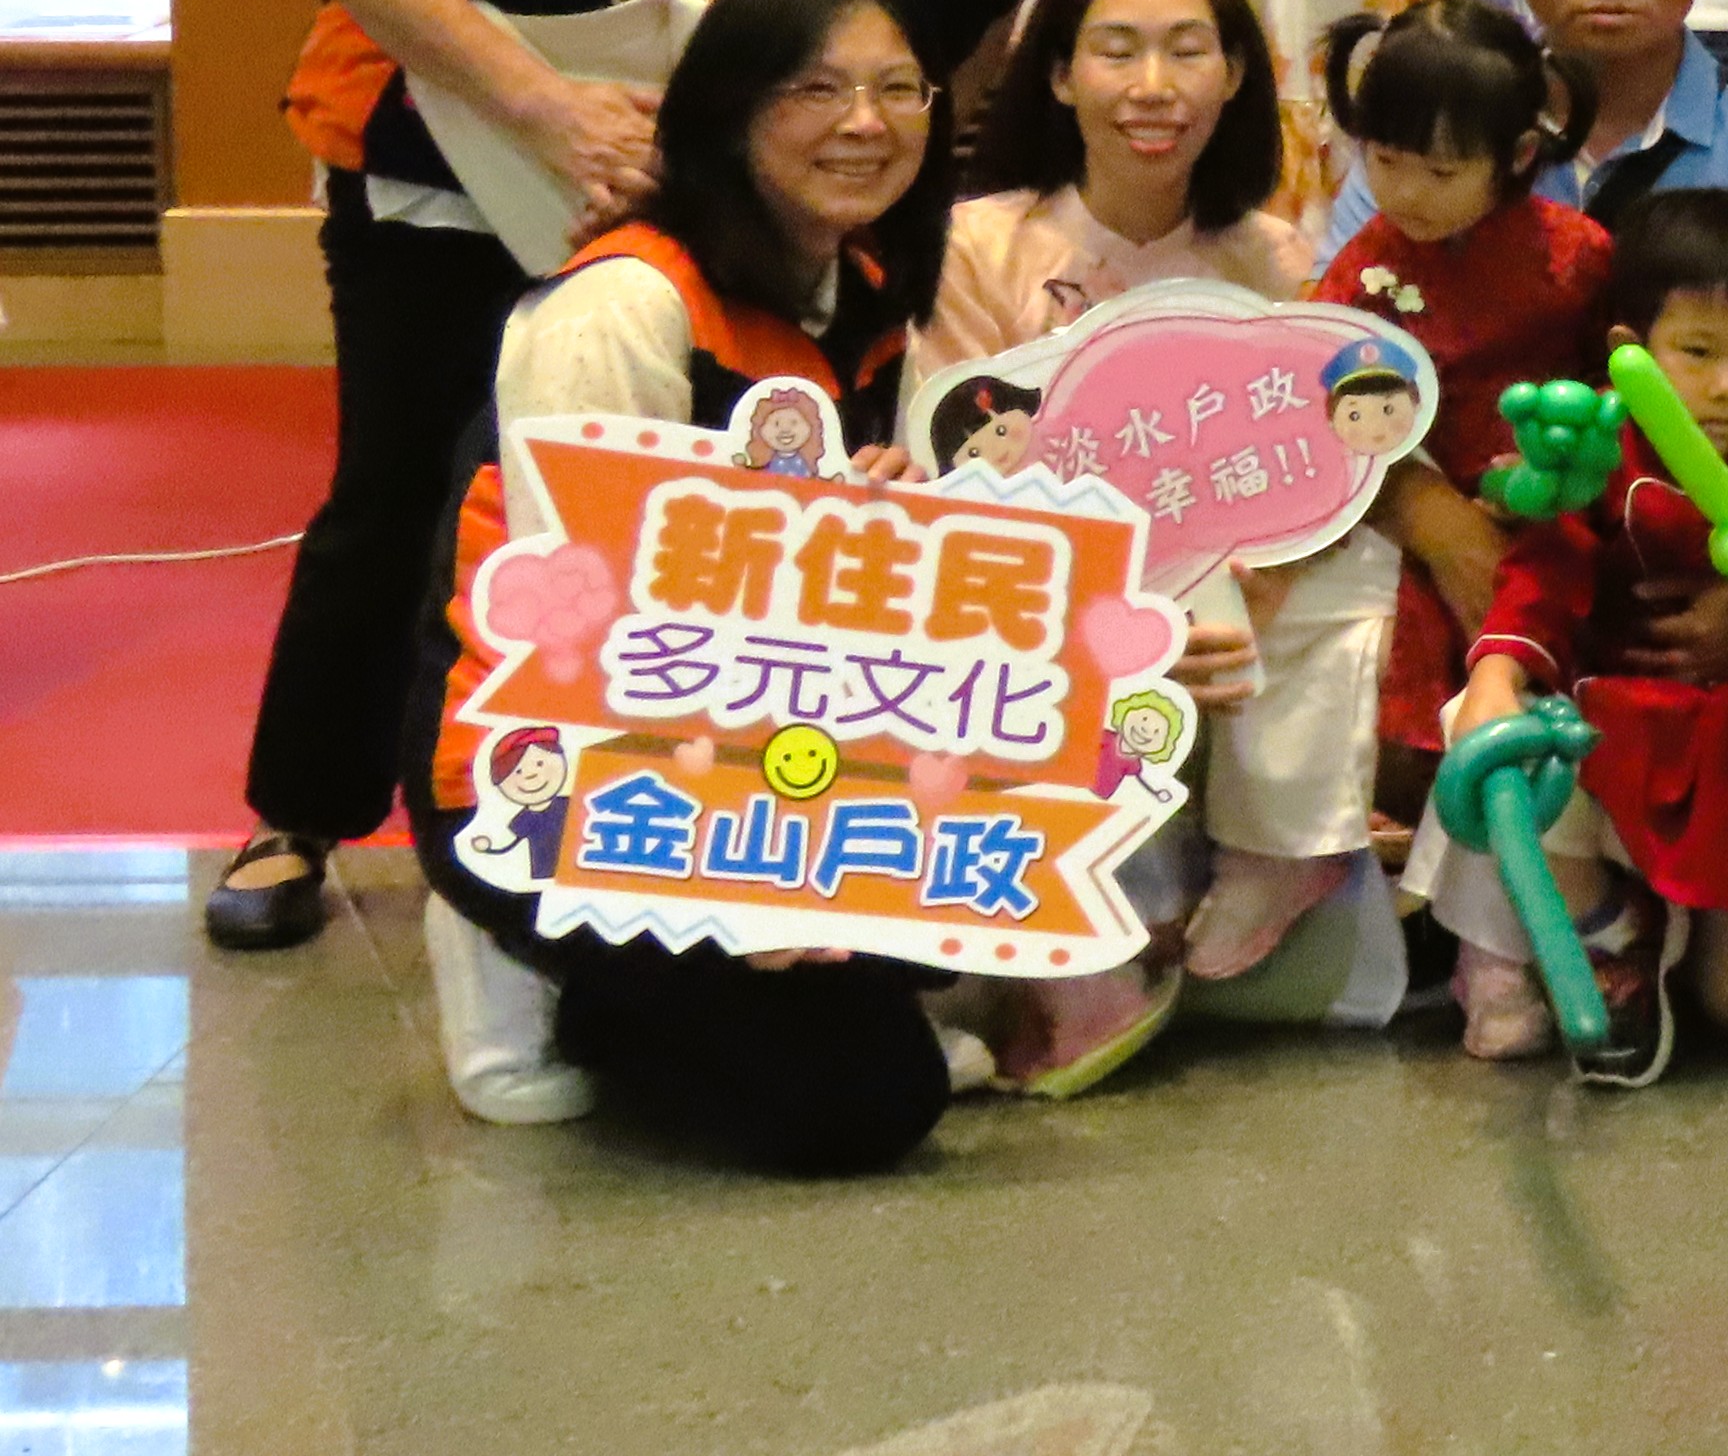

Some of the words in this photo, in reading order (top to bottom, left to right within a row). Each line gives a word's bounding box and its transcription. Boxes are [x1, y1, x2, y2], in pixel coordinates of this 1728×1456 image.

[654, 494, 1058, 649] 新住民
[617, 621, 1054, 744] 多元文化
[580, 772, 1042, 918] 金山戶政
